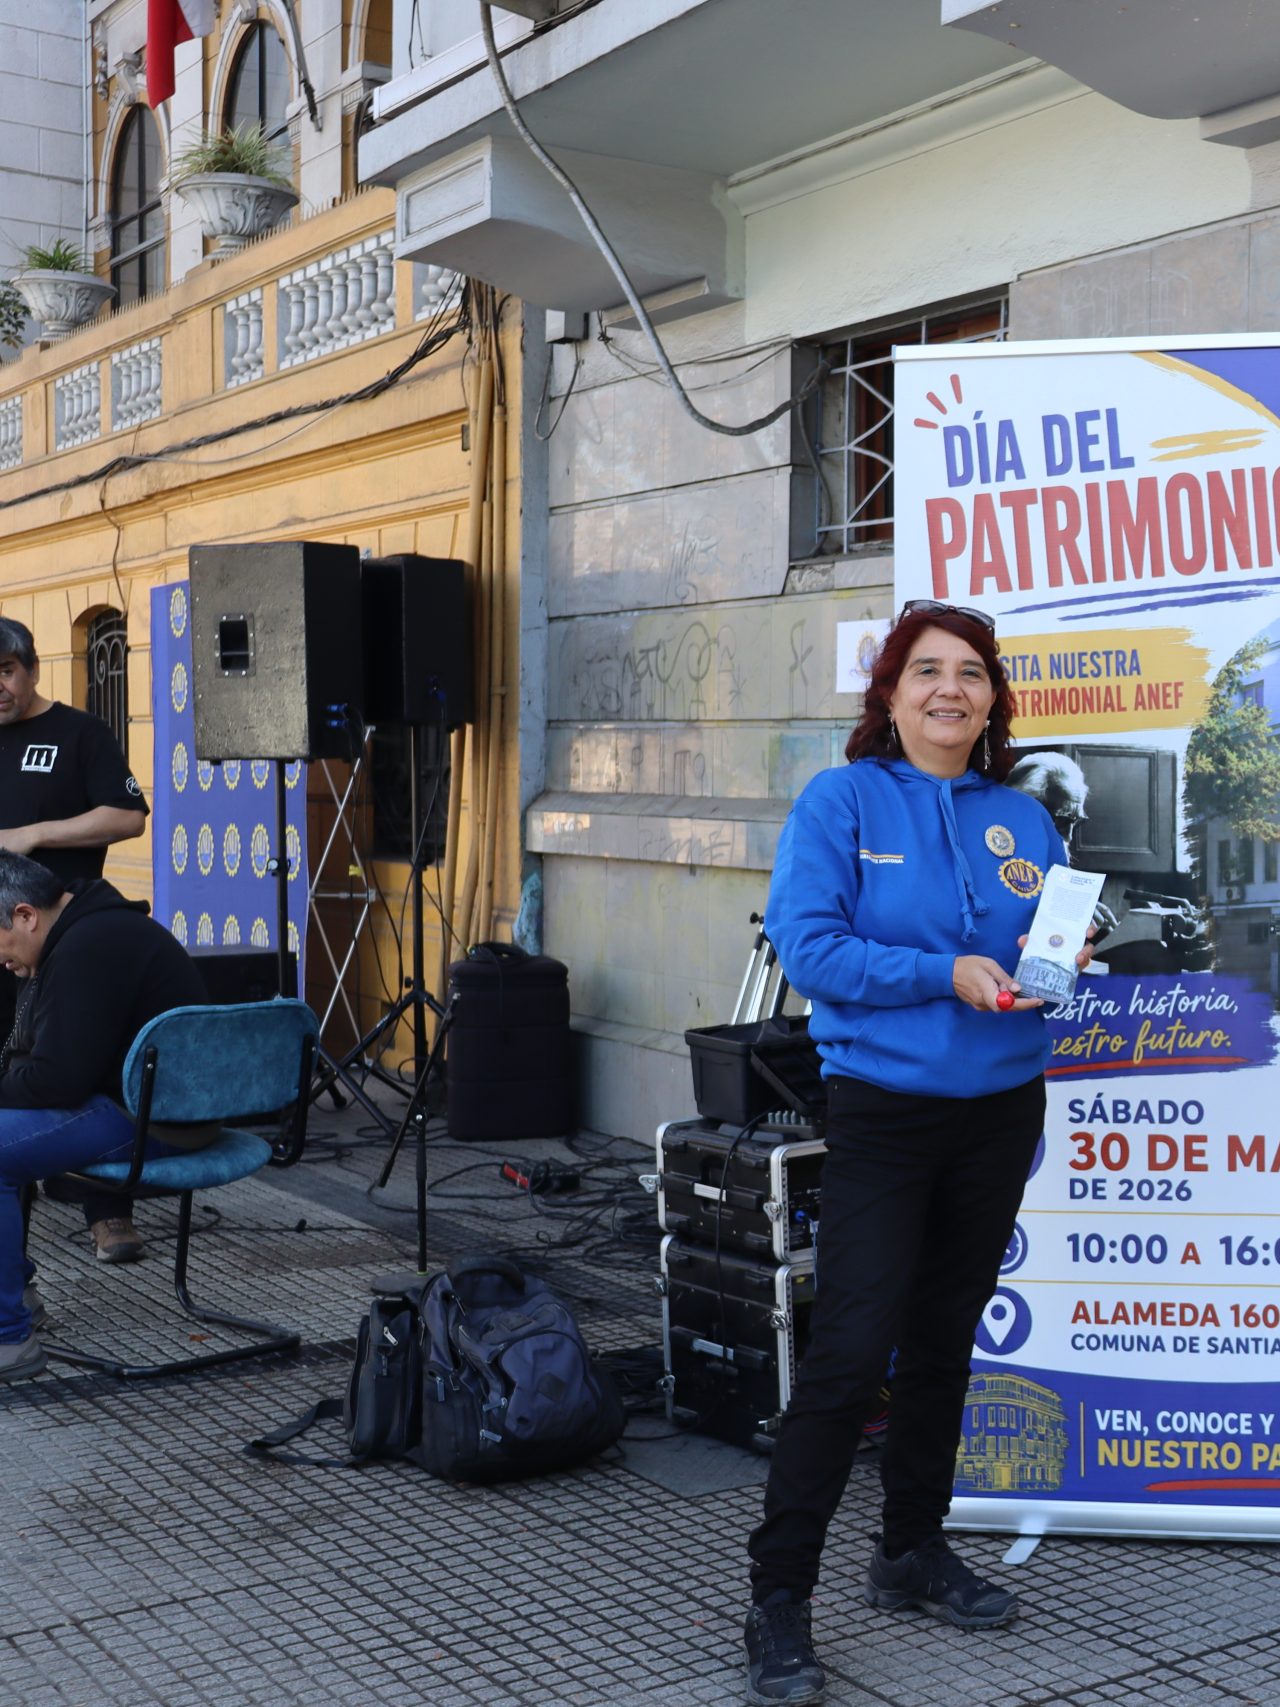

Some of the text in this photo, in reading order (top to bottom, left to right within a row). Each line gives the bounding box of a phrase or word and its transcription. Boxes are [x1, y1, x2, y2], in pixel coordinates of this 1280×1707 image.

[943, 408, 1135, 488] DÍA DEL
[1000, 649, 1142, 682] SITA NUESTRA
[1010, 681, 1185, 718] ATRIMONIAL ANEF
[1044, 983, 1239, 1023] estra historia,
[1132, 1018, 1232, 1065] futuro.
[1068, 1093, 1205, 1125] SÁBADO
[1069, 1131, 1130, 1172] 30
[1147, 1134, 1208, 1173] DE
[1069, 1178, 1193, 1202] DE 2026
[1066, 1233, 1168, 1264] 10:00
[1180, 1241, 1201, 1265] A
[1071, 1300, 1221, 1328] ALAMEDA
[1071, 1333, 1166, 1353] COMUNA
[1172, 1335, 1200, 1354] DE
[1095, 1408, 1149, 1436] VEN,
[1156, 1410, 1253, 1436] CONOCE
[1258, 1414, 1275, 1435] Y
[1097, 1439, 1243, 1470] NUESTRO
